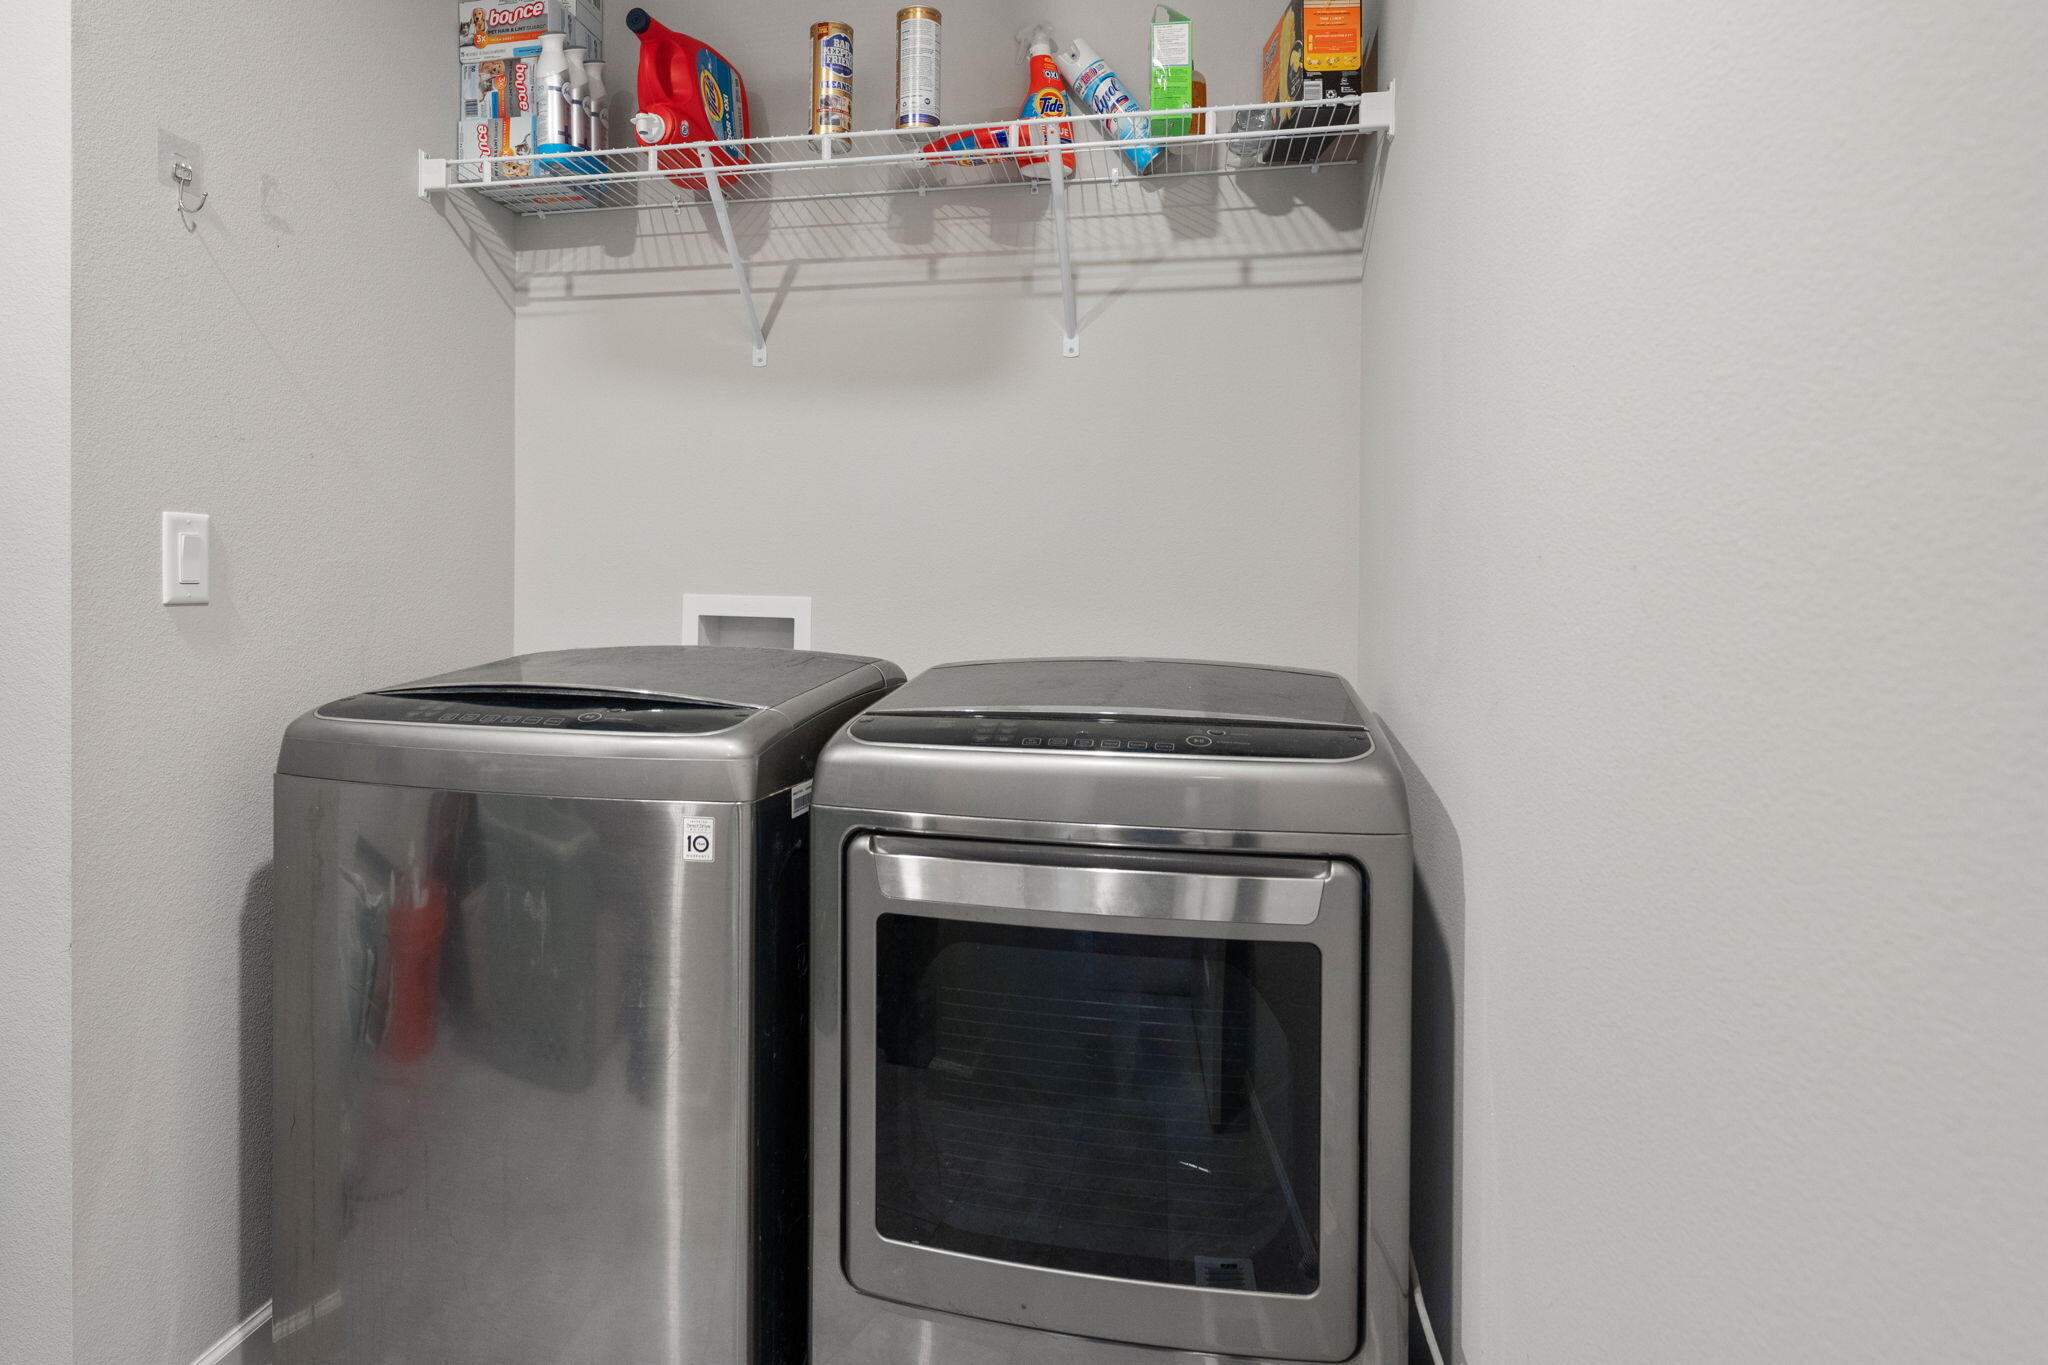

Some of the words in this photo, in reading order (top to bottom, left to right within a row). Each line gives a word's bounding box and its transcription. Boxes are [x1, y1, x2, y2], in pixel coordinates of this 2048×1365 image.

[489, 2, 544, 27] bounce
[833, 38, 850, 50] BAR
[1044, 70, 1058, 79] OXI
[515, 63, 529, 112] bounce
[1040, 97, 1064, 114] Tide
[477, 124, 491, 172] unce
[687, 835, 709, 852] 10
